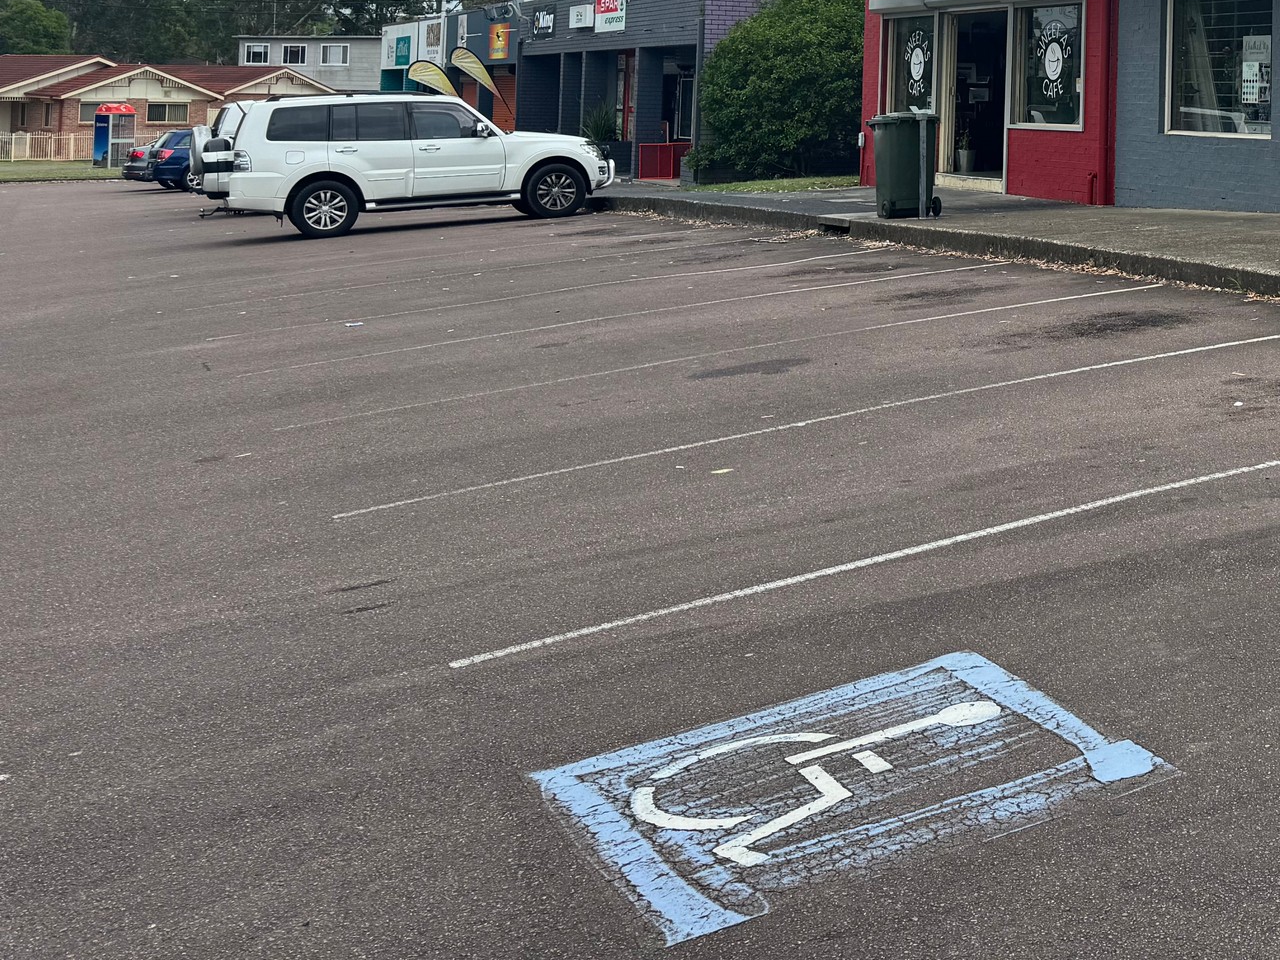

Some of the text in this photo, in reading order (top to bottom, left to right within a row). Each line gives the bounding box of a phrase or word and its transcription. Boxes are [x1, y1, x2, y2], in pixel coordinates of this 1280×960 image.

[538, 11, 555, 33] King
[604, 15, 625, 26] express
[904, 30, 931, 62] SWEET AS
[1037, 23, 1072, 59] SWEET AS
[908, 78, 925, 97] CAFE
[1042, 78, 1063, 99] CAFE
